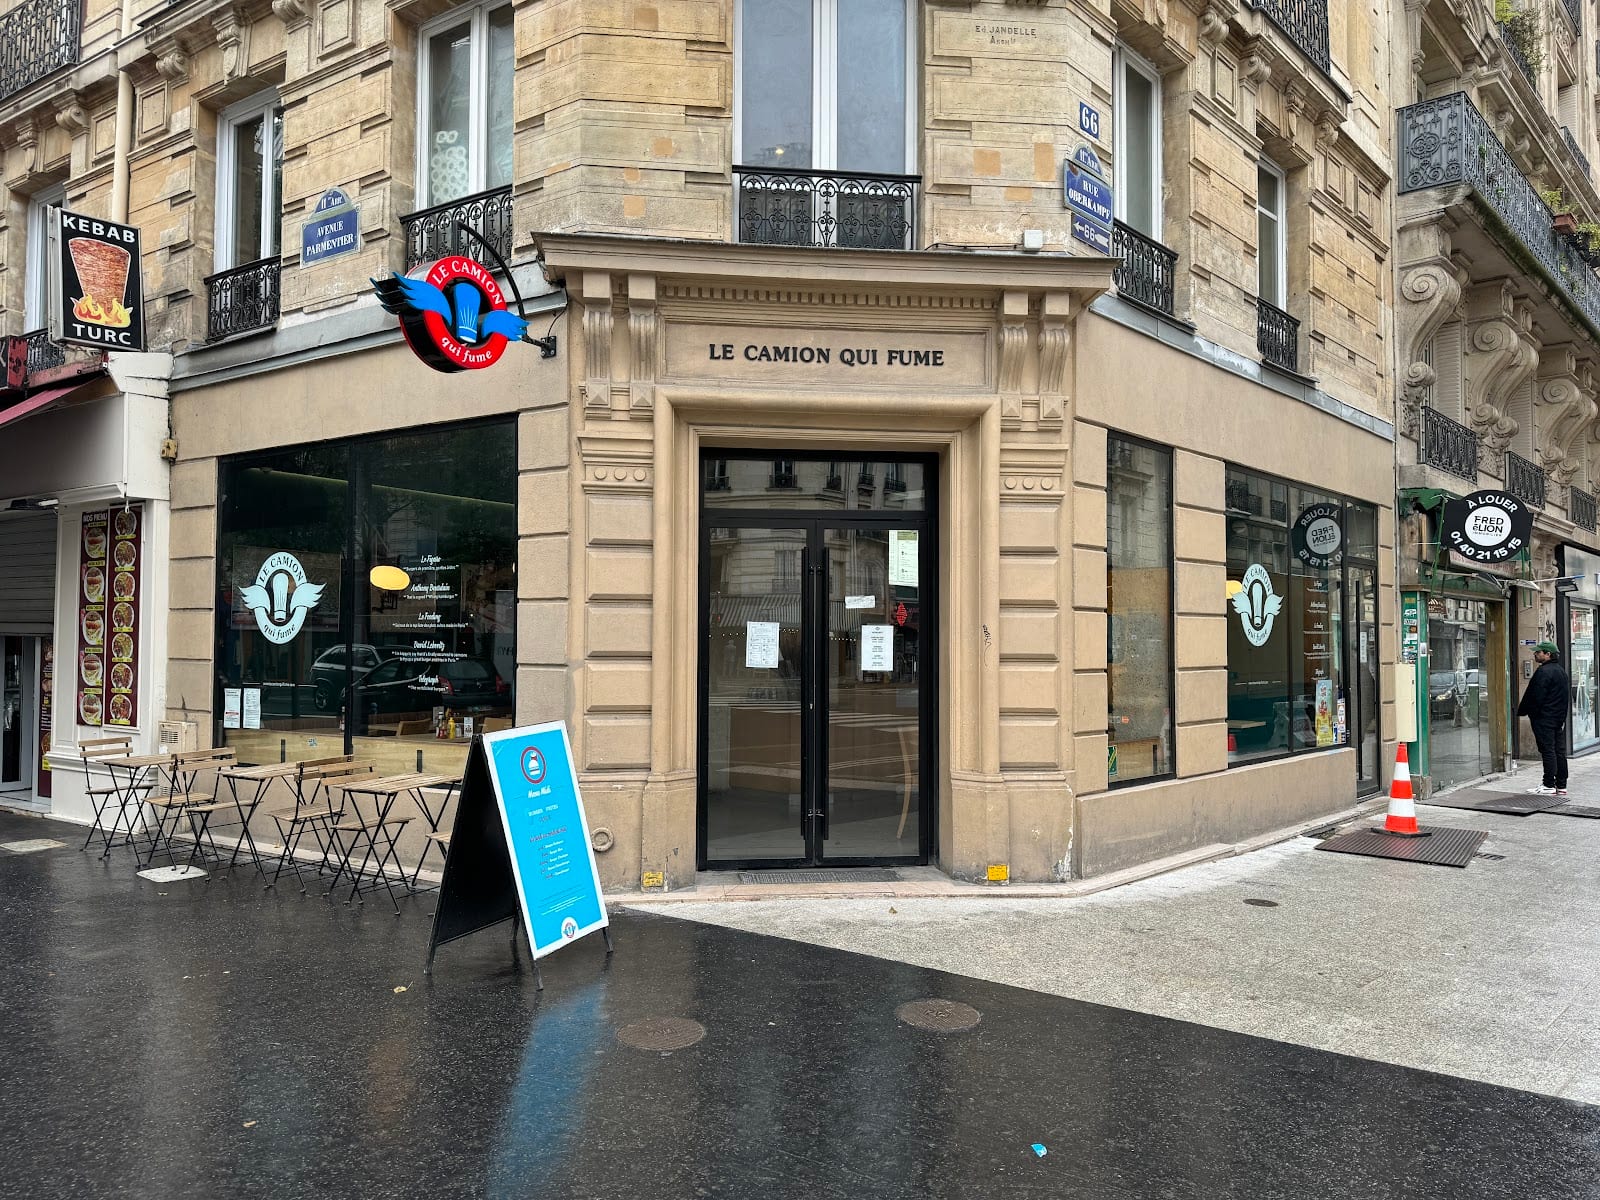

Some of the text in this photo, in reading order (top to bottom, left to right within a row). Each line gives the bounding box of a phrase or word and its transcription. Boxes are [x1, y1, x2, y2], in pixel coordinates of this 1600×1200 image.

[989, 26, 1037, 36] JANDELLE
[1081, 106, 1098, 135] 66
[1082, 180, 1099, 198] RUE
[1068, 188, 1110, 220] OBERKAMPF
[62, 214, 136, 243] KEBAB
[316, 221, 343, 238] AVENUE
[1084, 223, 1095, 242] 66
[306, 233, 354, 256] PARMENTIER
[432, 260, 503, 305] LE CAMION
[72, 323, 131, 345] TURC
[441, 337, 493, 363] qui fume
[709, 343, 944, 367] LE CAMION QUI FUME
[1478, 494, 1518, 513] LOUER
[1474, 515, 1504, 525] FRED
[1450, 531, 1522, 560] 01 40 21 15 15
[259, 556, 304, 583] LE CAMION
[263, 624, 296, 641] qui fume
